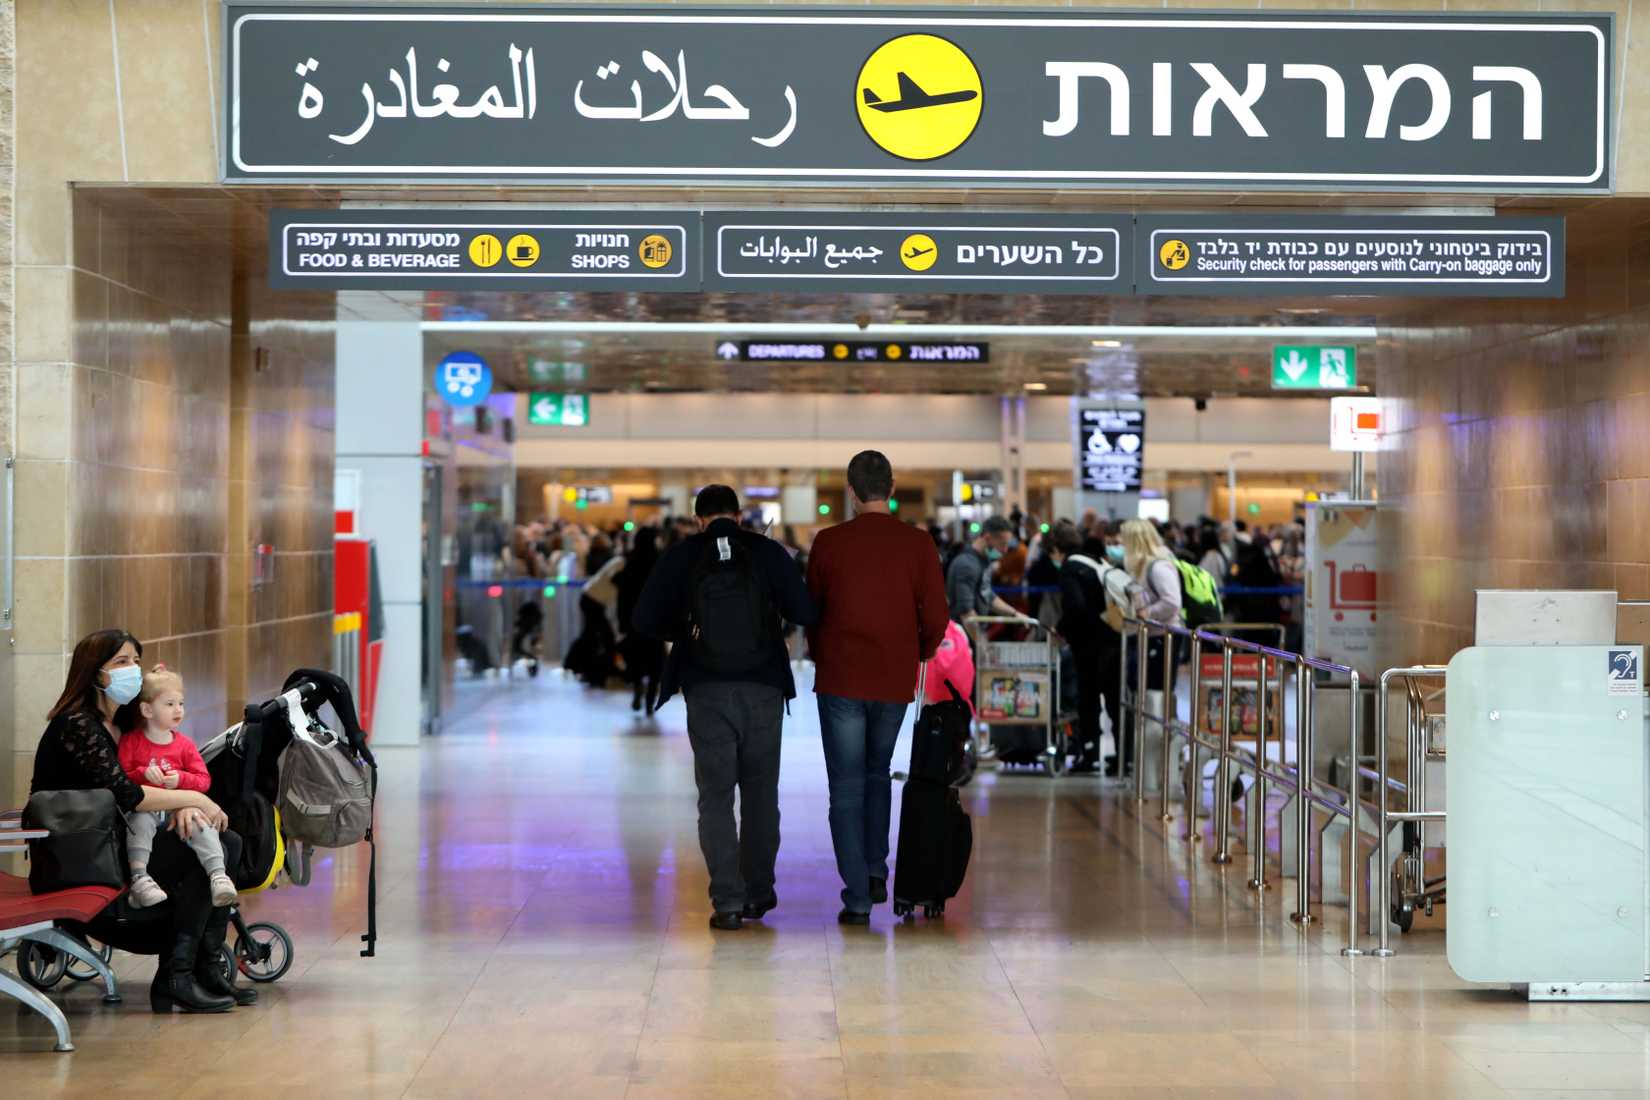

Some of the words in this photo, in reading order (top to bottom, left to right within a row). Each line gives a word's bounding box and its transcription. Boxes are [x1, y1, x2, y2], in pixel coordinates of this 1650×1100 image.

[295, 43, 537, 145] المغادرة
[574, 49, 797, 148] رحلات
[1043, 61, 1543, 141] המראות
[297, 232, 337, 250] קפה
[342, 233, 381, 247] ובתי
[386, 233, 460, 249] מסעדות
[575, 233, 629, 248] חנויות
[1197, 238, 1239, 255] בלבד
[1245, 242, 1260, 255] יד
[1267, 241, 1318, 255] כבודת
[1356, 239, 1423, 257] לנוסעים
[740, 235, 818, 265] البوابات
[824, 244, 882, 268] جميع
[957, 244, 1062, 265] השערים
[1071, 241, 1104, 264] כל
[1325, 242, 1349, 257] עם
[1430, 242, 1491, 256] ביטחוני
[1497, 242, 1543, 259] בידוק
[299, 253, 347, 268] FOOD
[351, 253, 363, 268] &
[368, 253, 460, 268] BEVERAGE
[571, 254, 630, 268] SHOPS
[1197, 257, 1247, 274] Security
[1249, 257, 1286, 271] check
[1288, 257, 1305, 271] for
[1308, 259, 1378, 274] passengers
[1381, 258, 1406, 271] with
[1409, 257, 1461, 275] Carry-on
[1465, 257, 1513, 276] baggage
[1515, 258, 1542, 275] only
